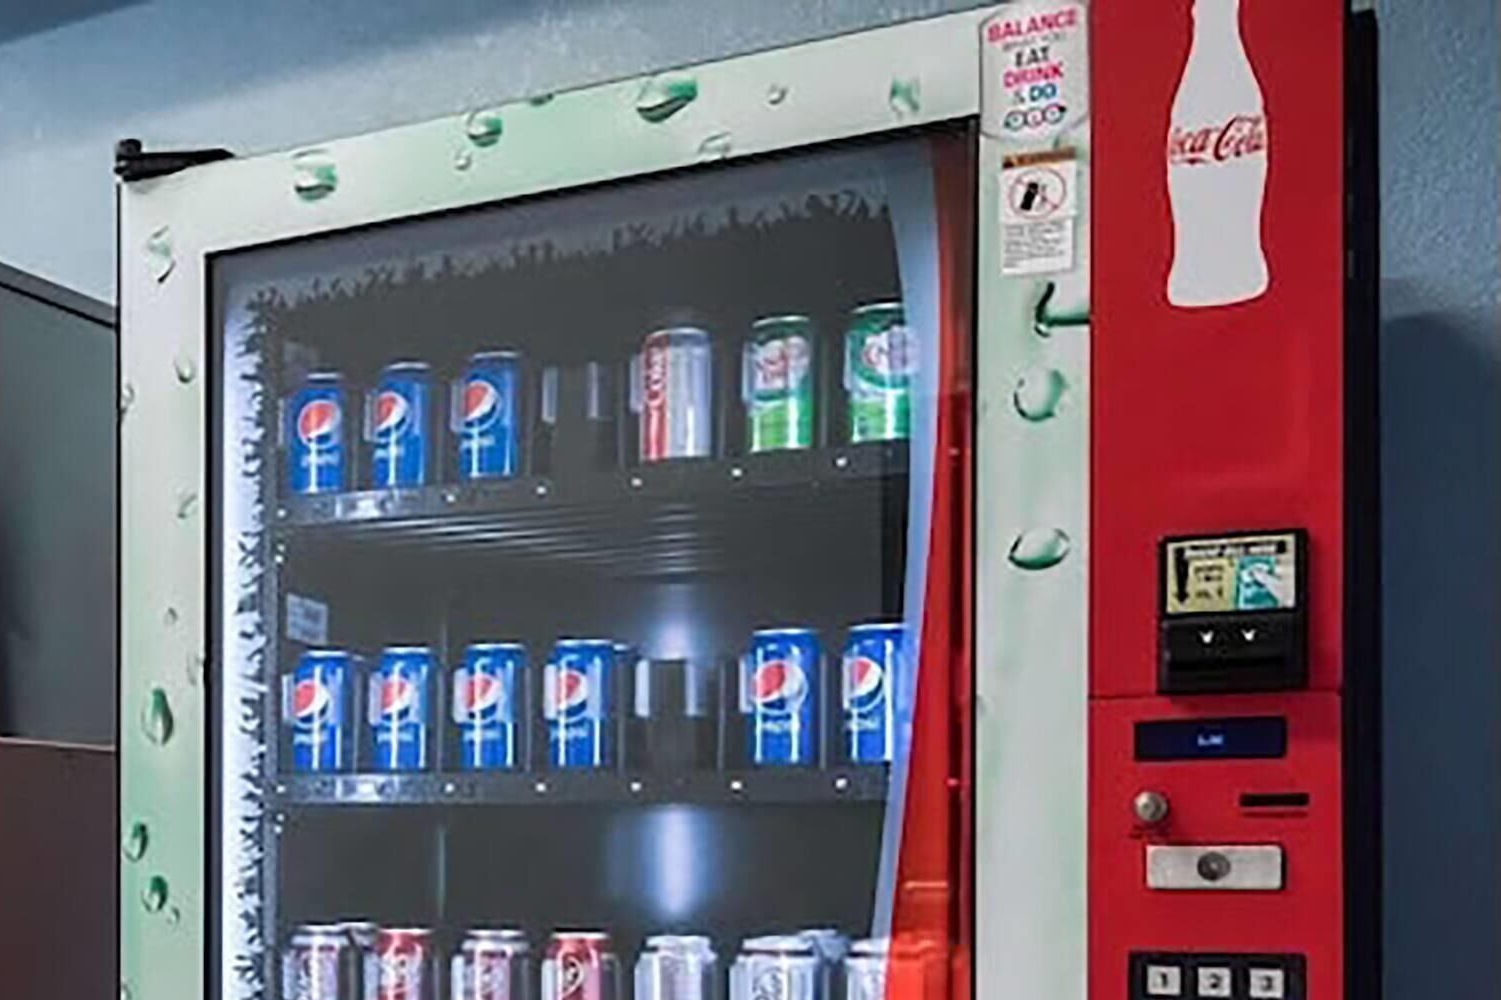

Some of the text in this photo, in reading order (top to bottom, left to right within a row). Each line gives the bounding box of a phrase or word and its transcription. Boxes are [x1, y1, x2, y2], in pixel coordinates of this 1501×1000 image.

[988, 9, 1076, 42] BALANCE
[1015, 46, 1049, 67] EAT
[1004, 61, 1064, 88] DRINK
[1029, 83, 1057, 102] DO
[1159, 972, 1169, 988] 1
